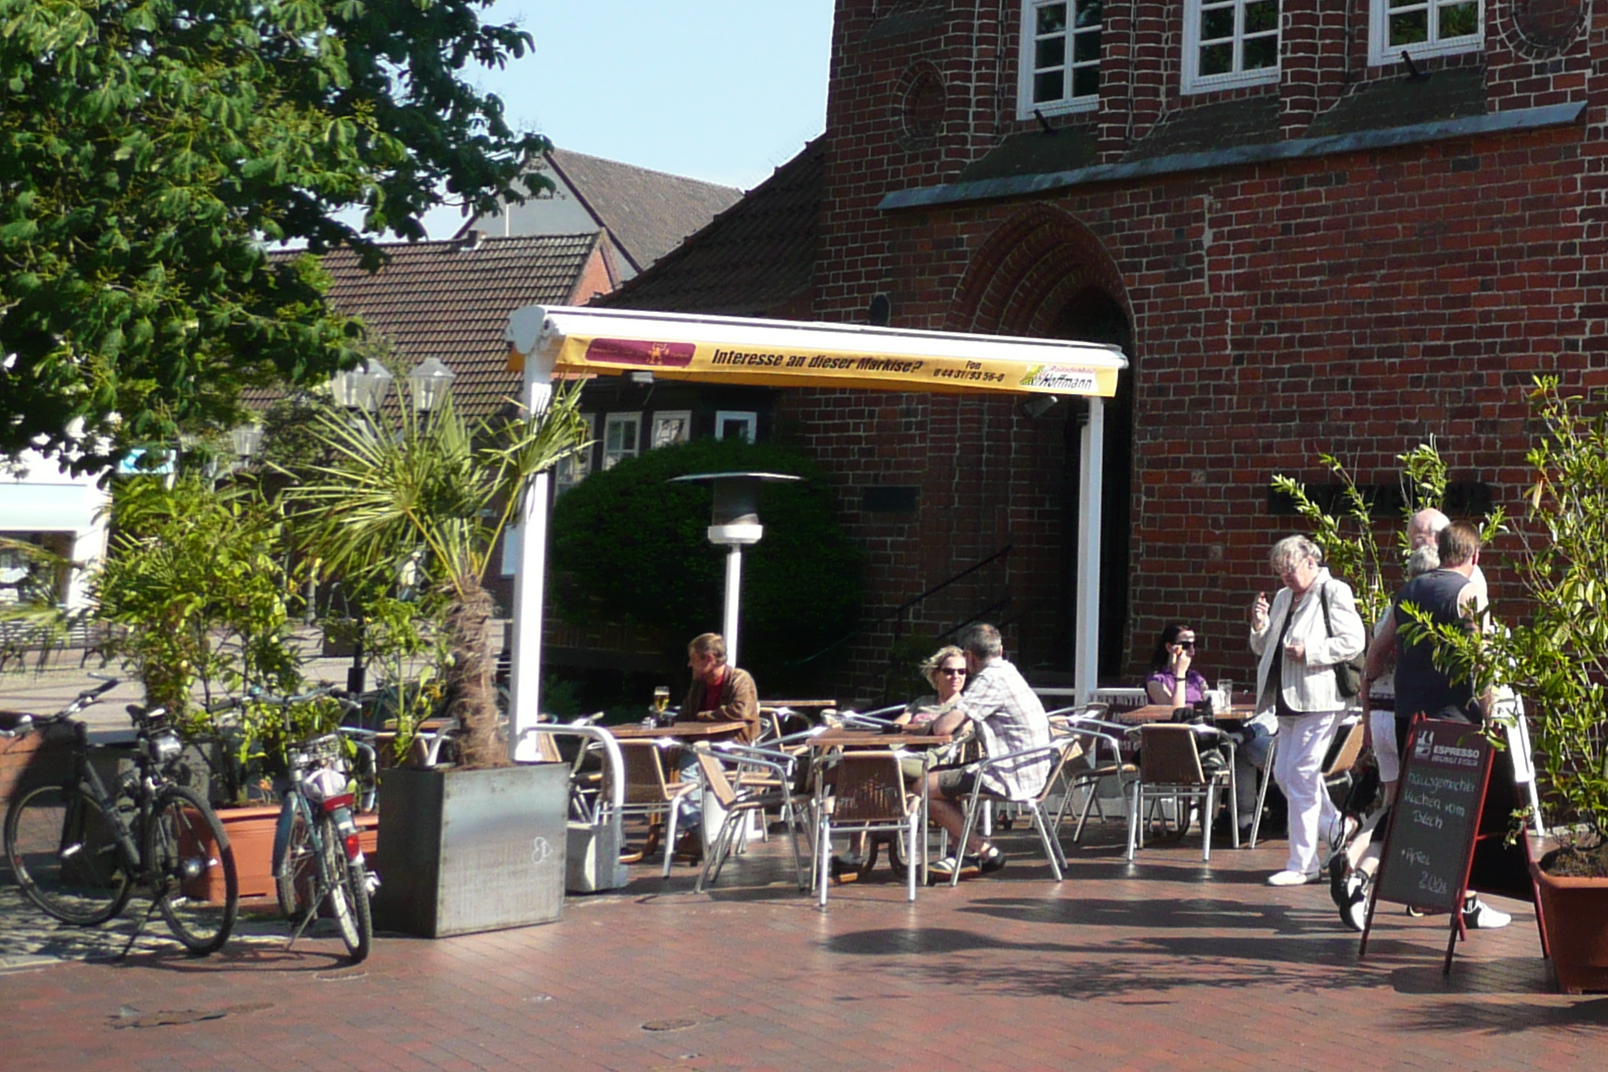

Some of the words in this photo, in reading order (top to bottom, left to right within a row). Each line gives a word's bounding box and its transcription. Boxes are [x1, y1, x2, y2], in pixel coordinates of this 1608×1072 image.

[712, 349, 783, 366] Interesse
[786, 355, 805, 367] an
[808, 353, 854, 370] dieser
[856, 357, 924, 375] Markise?
[1039, 373, 1093, 389] Hoffmann
[1433, 745, 1480, 759] ESPRESSO
